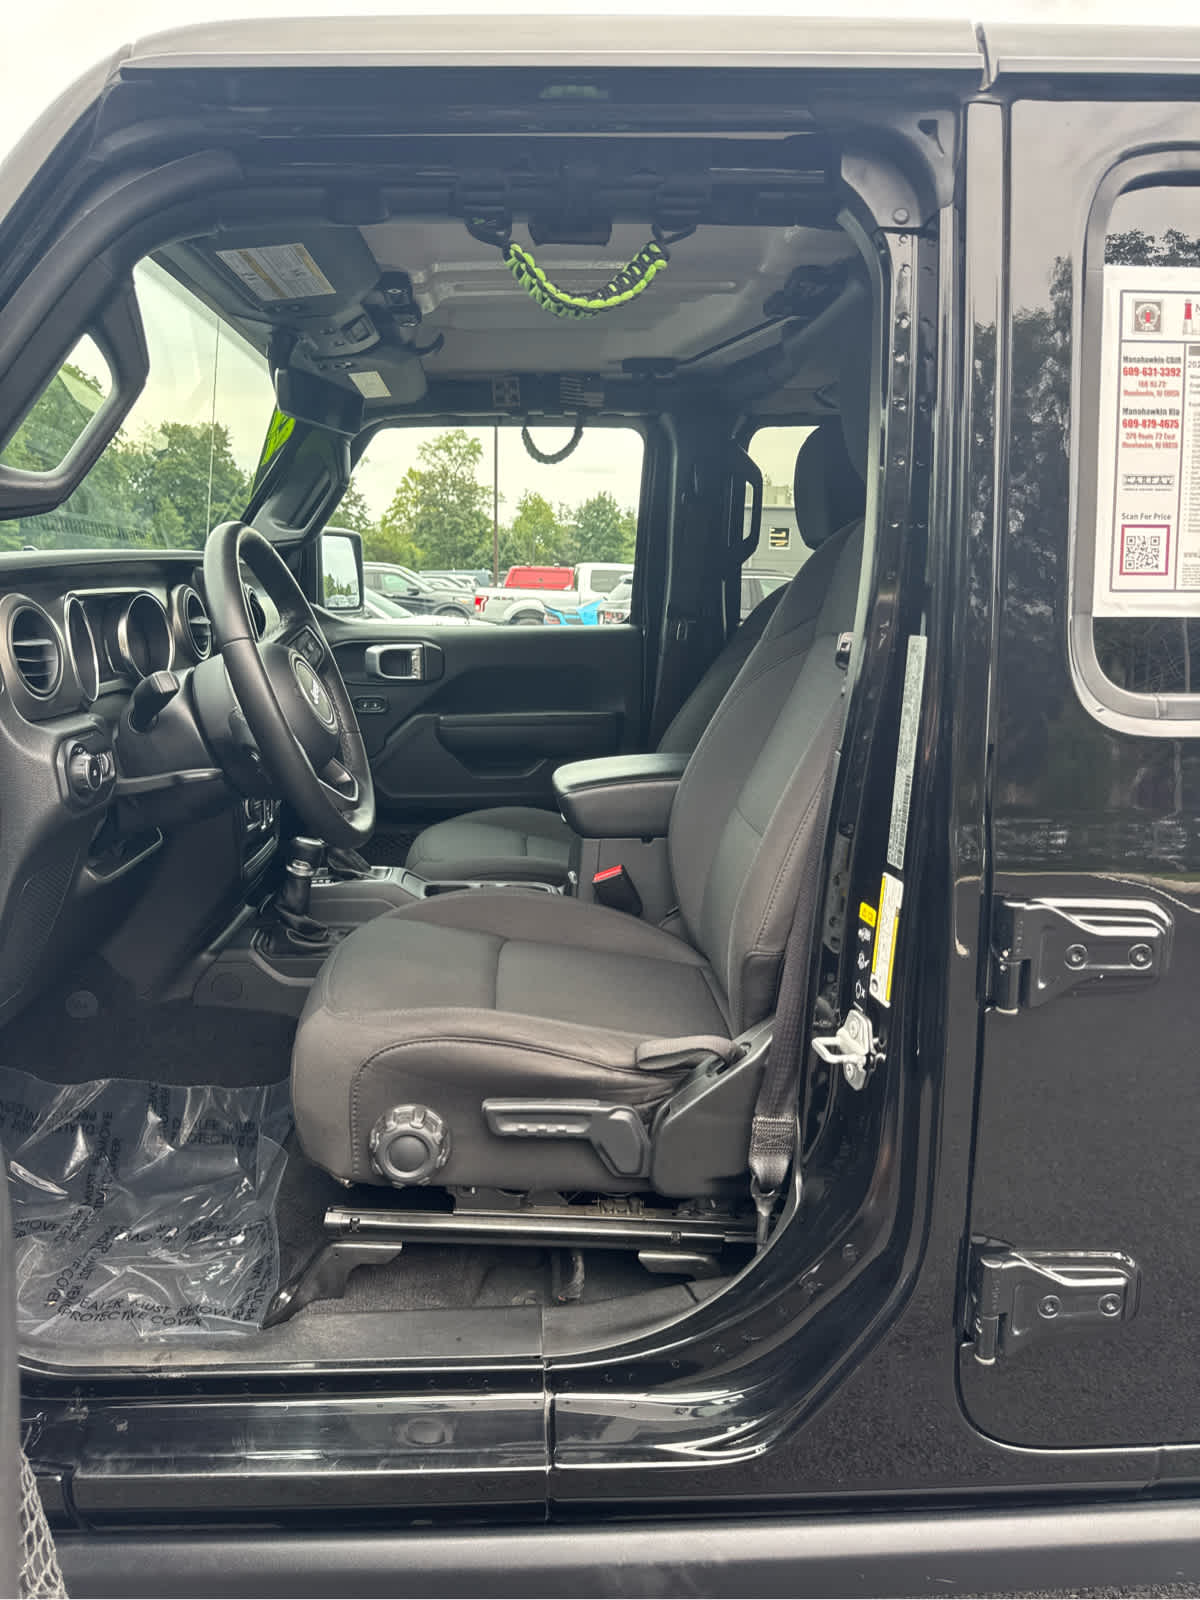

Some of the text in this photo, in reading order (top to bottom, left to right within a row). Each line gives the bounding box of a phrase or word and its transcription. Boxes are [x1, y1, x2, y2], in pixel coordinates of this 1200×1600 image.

[1122, 407, 1167, 416] Manahawkin
[1121, 512, 1172, 521] Scan For Price
